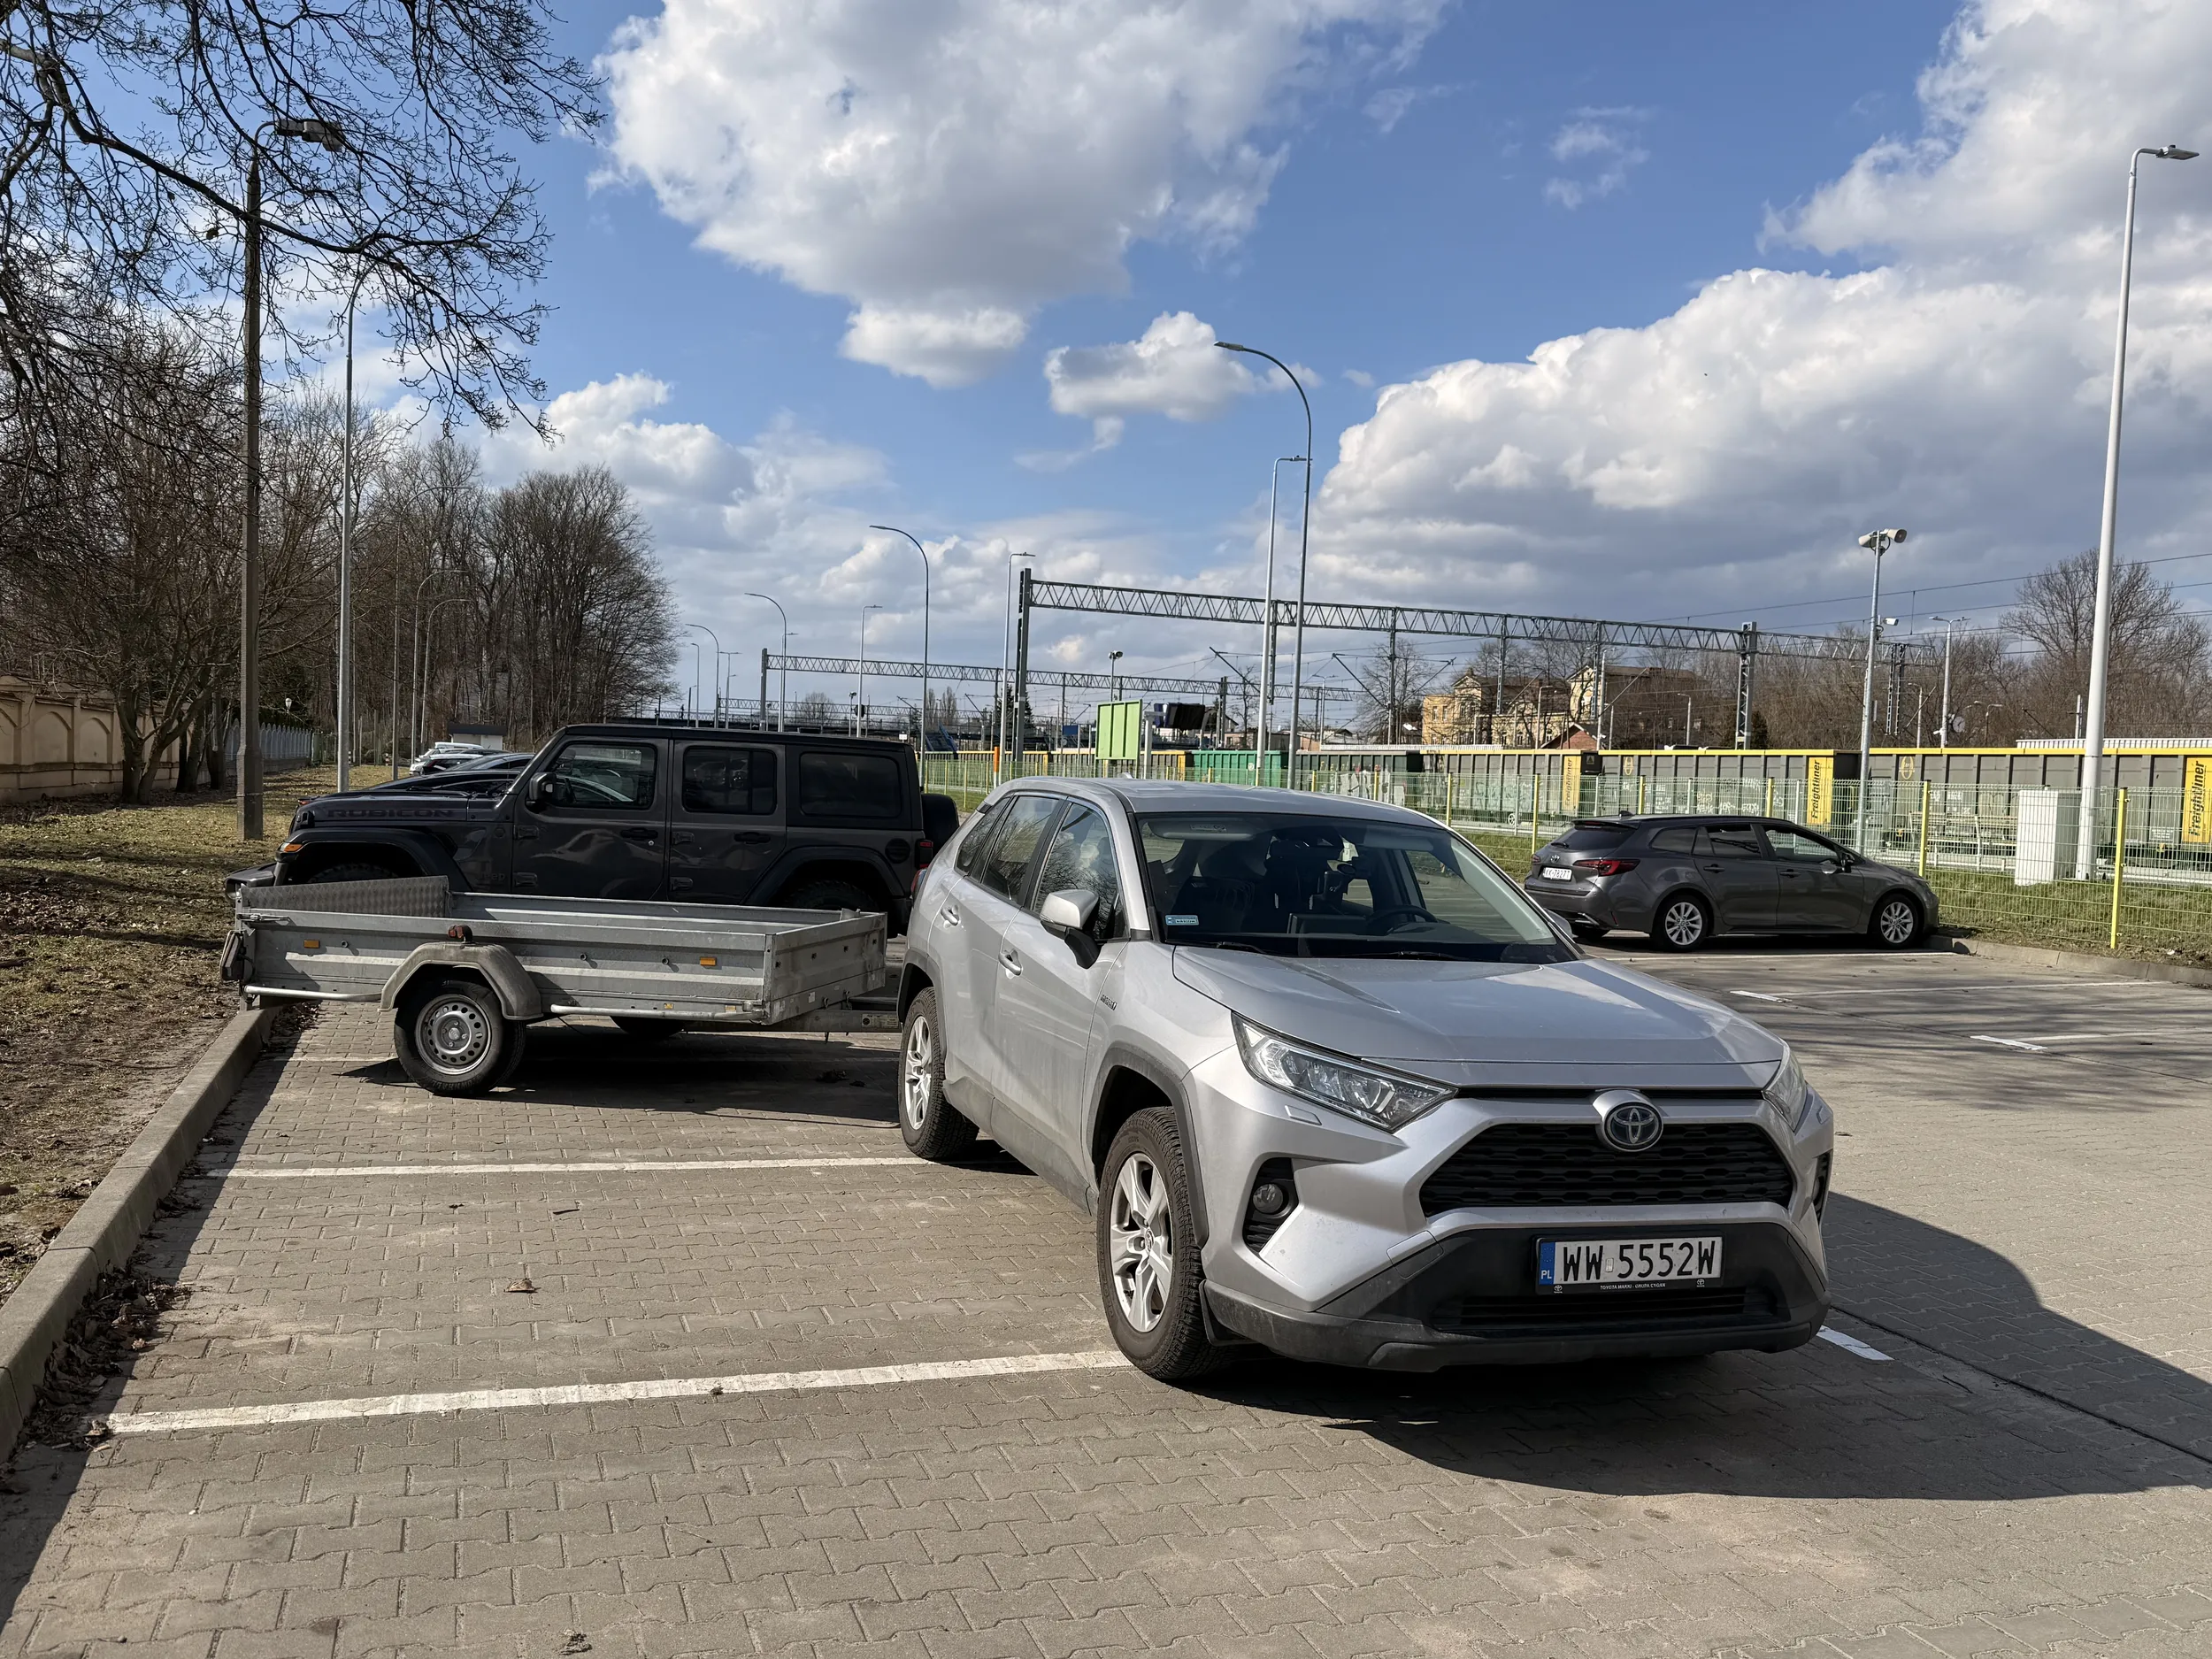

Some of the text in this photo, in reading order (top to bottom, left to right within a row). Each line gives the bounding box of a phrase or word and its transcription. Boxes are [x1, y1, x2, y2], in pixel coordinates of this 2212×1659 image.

[1811, 759, 1821, 819] Freightliner
[2188, 760, 2205, 837] Freightliner
[327, 809, 455, 818] RUBICON
[1540, 1270, 1552, 1279] PL
[1563, 1240, 1716, 1282] WW 5552W
